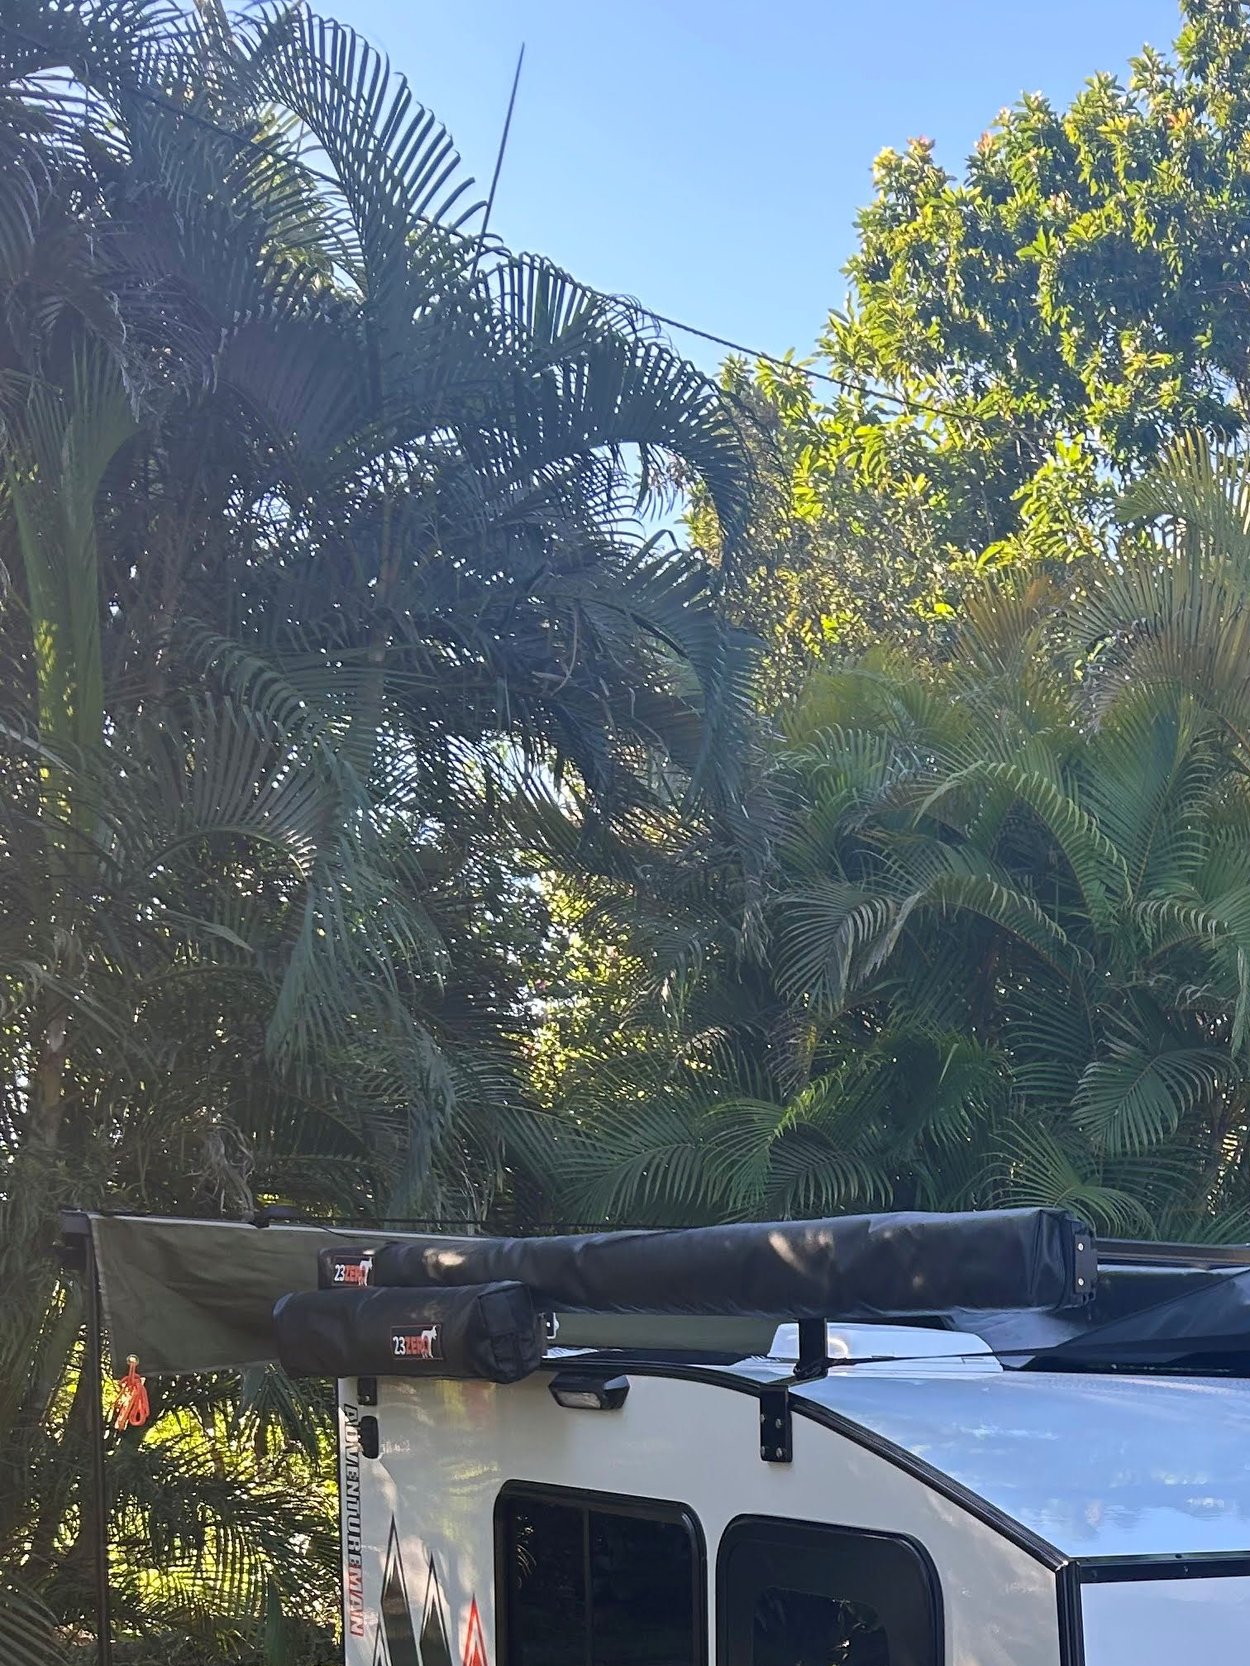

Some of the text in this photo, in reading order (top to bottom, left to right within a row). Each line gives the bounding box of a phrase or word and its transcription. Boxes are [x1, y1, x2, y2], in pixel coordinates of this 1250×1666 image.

[334, 1264, 366, 1286] 23ZERO
[392, 1335, 430, 1356] 23ZERO
[344, 1404, 365, 1637] ADVENTUREMAN
